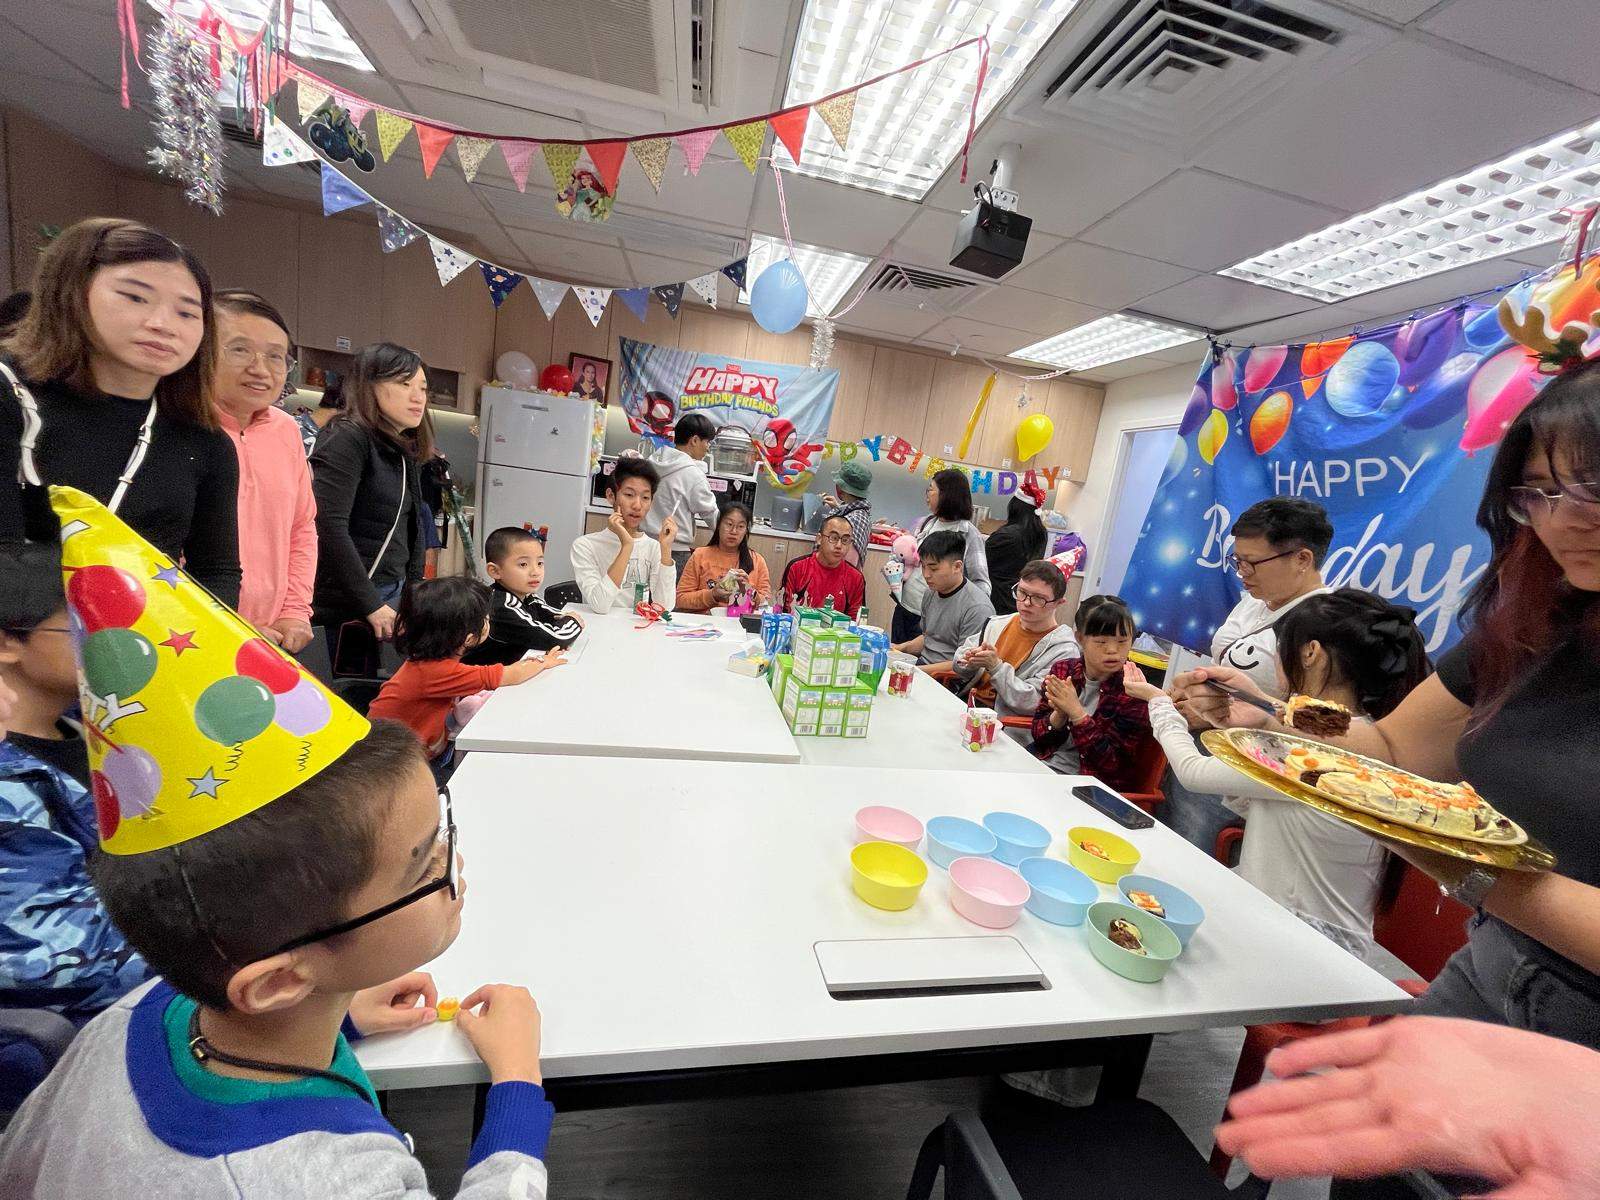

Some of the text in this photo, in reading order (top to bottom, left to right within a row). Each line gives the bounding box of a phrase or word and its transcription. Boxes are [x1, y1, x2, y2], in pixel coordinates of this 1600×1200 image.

[685, 367, 779, 403] HAPPY
[735, 393, 779, 418] FRIENDS
[1274, 451, 1427, 497] HAPPY
